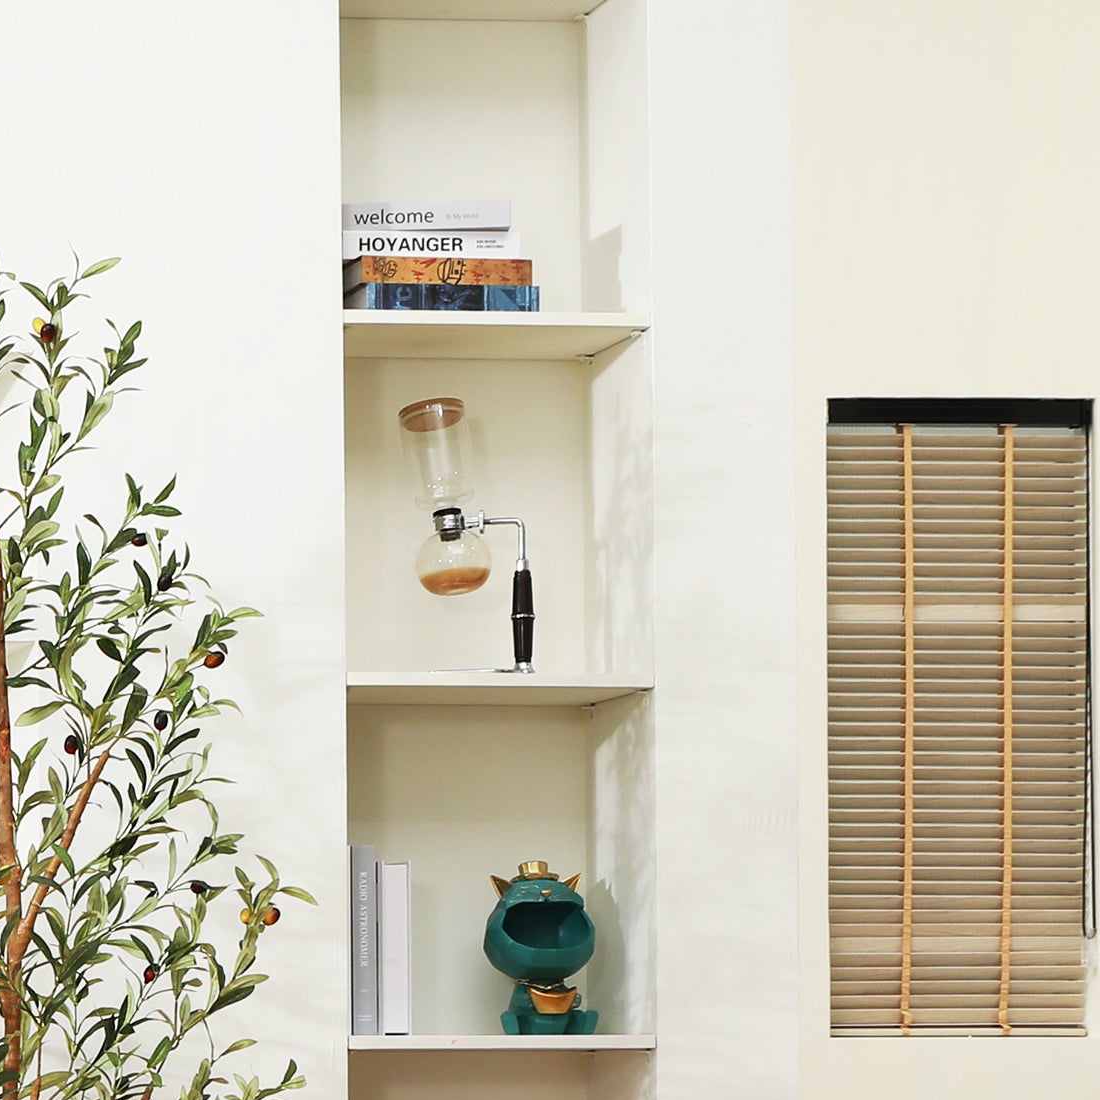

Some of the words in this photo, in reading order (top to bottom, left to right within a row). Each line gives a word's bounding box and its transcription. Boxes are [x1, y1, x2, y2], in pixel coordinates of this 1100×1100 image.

[353, 208, 435, 225] welcome
[358, 237, 464, 252] HOYANGER
[359, 871, 368, 902] RADIO
[359, 905, 369, 968] ASTRONOMER
